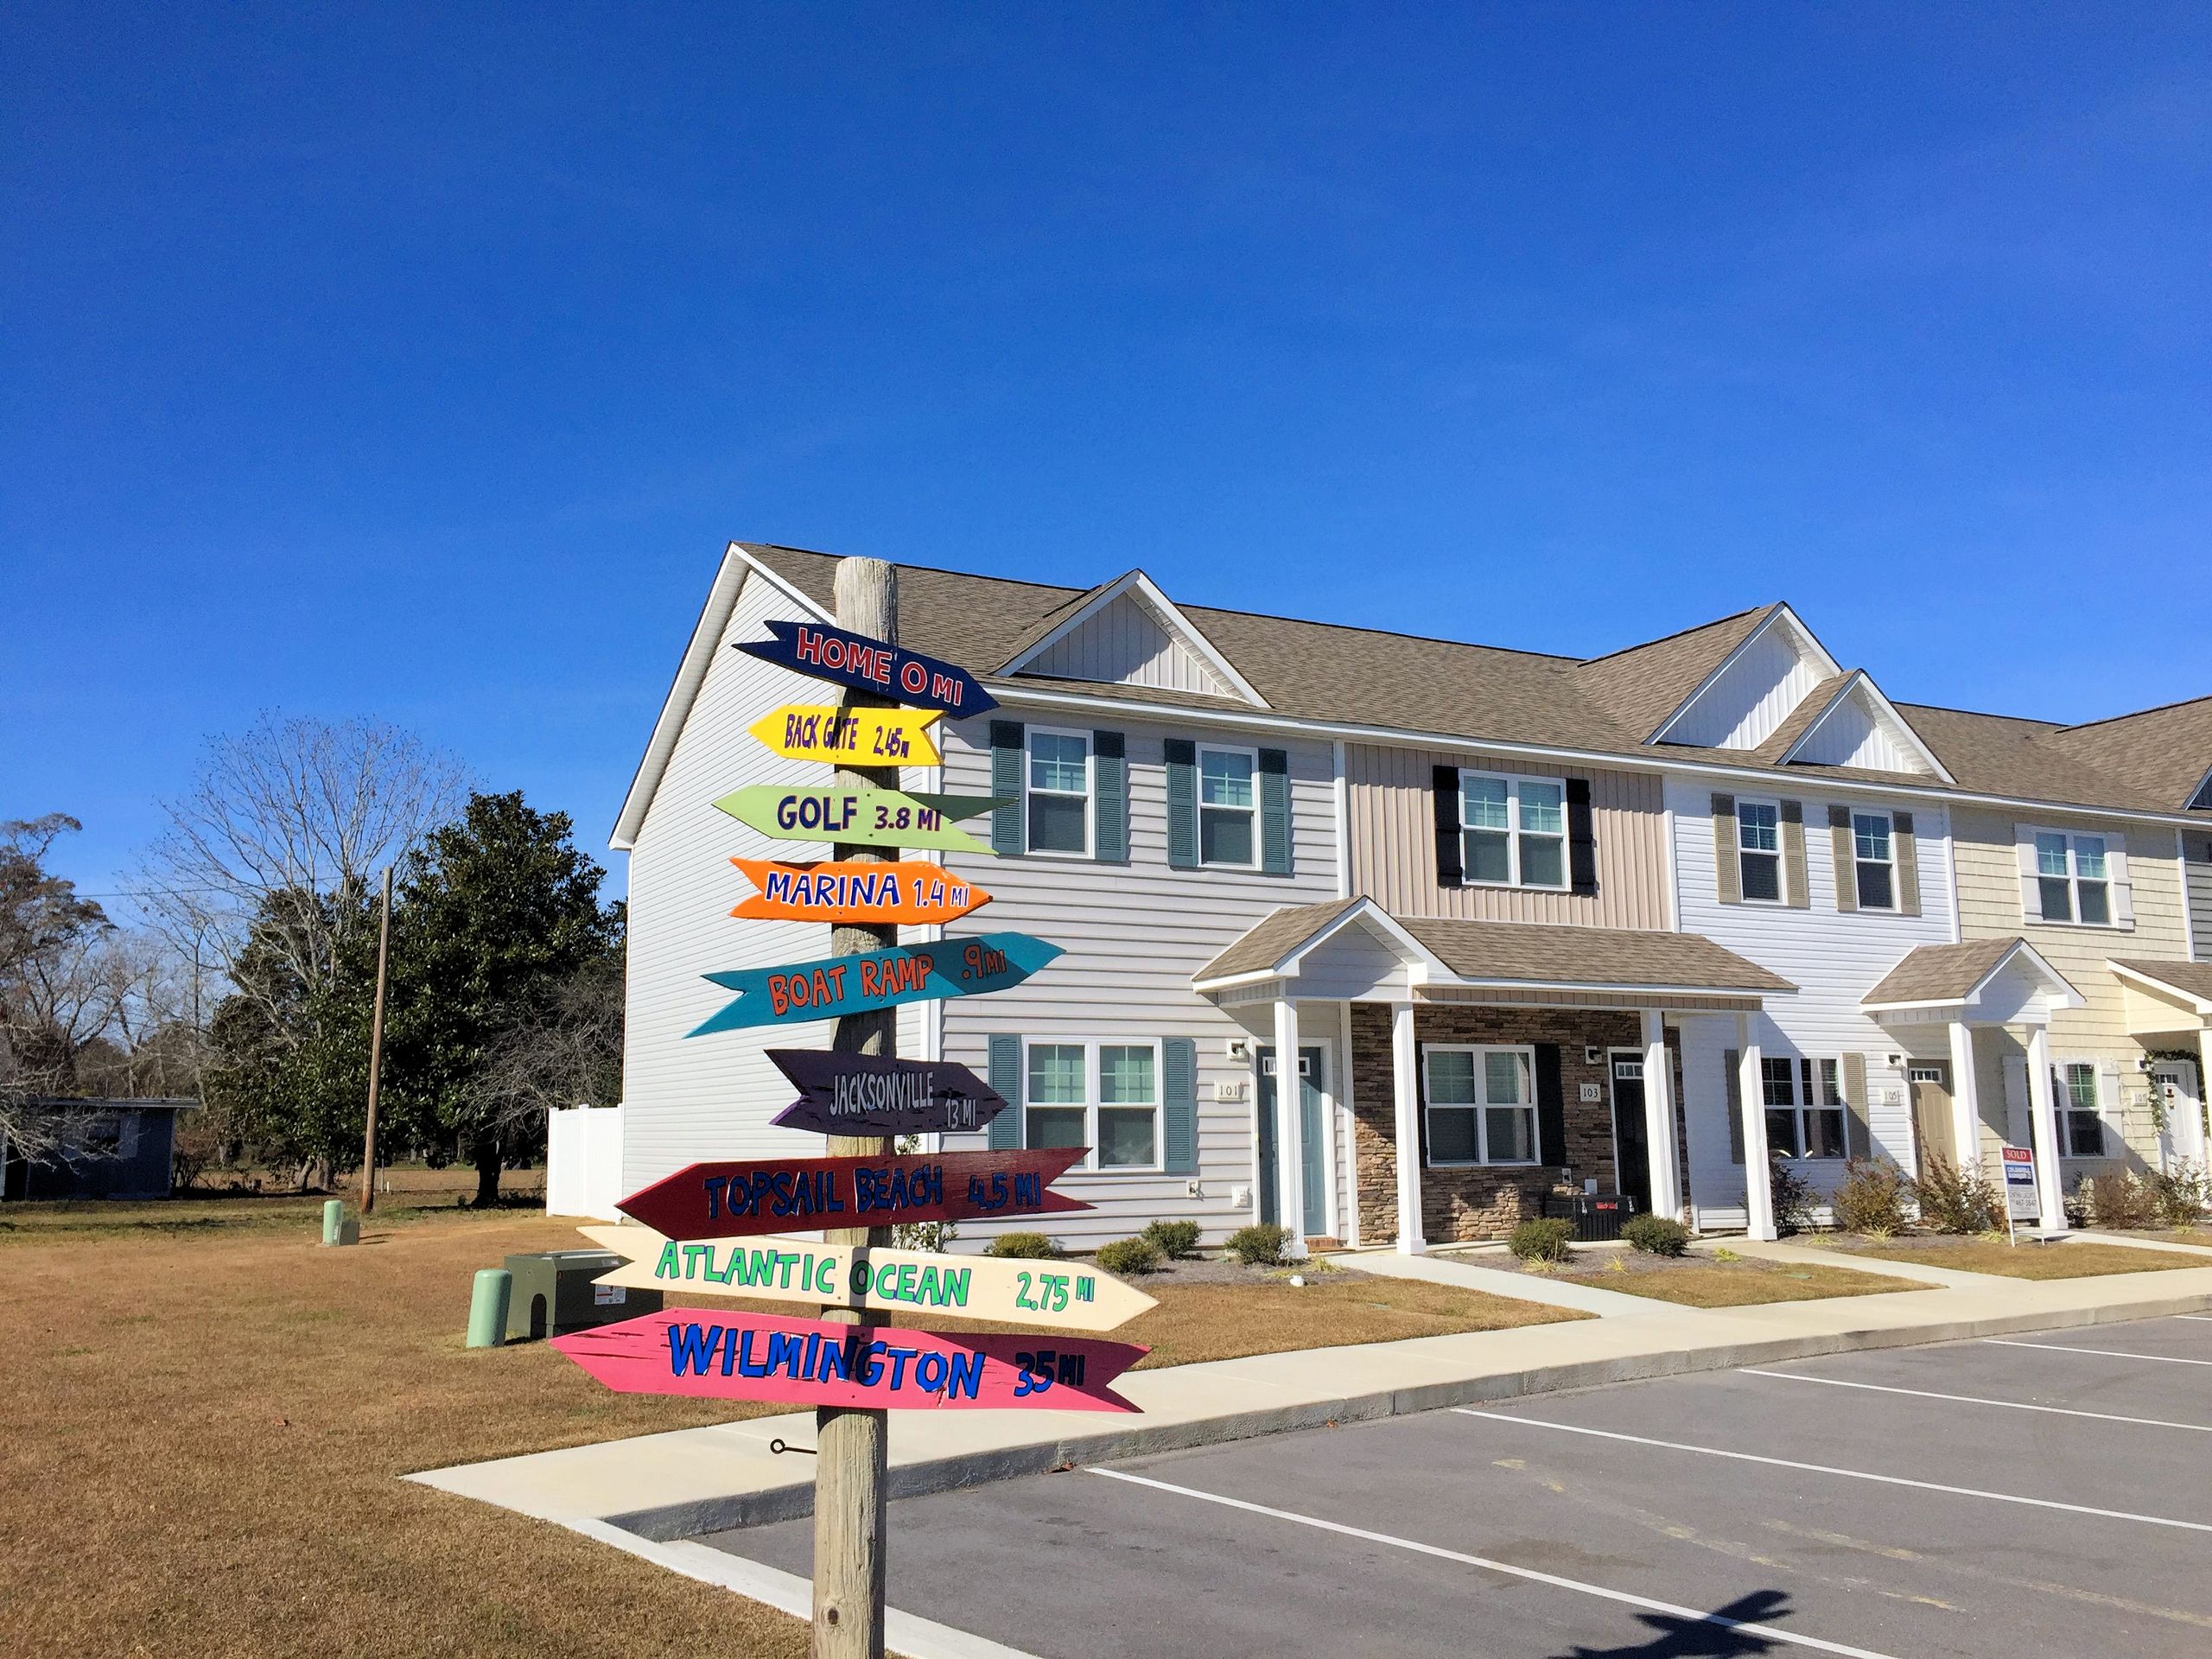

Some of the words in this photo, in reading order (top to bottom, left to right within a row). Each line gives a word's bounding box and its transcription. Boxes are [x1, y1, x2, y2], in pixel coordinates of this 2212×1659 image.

[796, 627, 893, 684] HOME
[931, 673, 963, 707] MI
[785, 714, 821, 749] BACK
[823, 715, 859, 750] GATE
[778, 795, 857, 832] GOLF
[874, 805, 911, 830] 3.8
[918, 809, 942, 832] MI
[764, 871, 903, 907] MARINA
[912, 878, 944, 907] 1.4
[950, 886, 969, 908] MI
[767, 963, 846, 1016] BOAT
[860, 954, 934, 997] RAMP
[830, 1071, 934, 1116] JACKSONVILLE
[945, 1099, 959, 1129] 13
[963, 1098, 976, 1127] MI
[1220, 1085, 1237, 1096] 101
[1583, 1088, 1599, 1098] 103
[2005, 1149, 2027, 1160] SOLD
[704, 1171, 845, 1219] TOPSAIL
[855, 1165, 944, 1211] BEACH
[968, 1173, 1008, 1210] 4.5
[1014, 1172, 1042, 1206] MI
[654, 1241, 836, 1294] ATLANTIC
[849, 1258, 972, 1307] OCEAN
[1015, 1271, 1070, 1313] 2.75
[1076, 1275, 1095, 1303] MI
[667, 1323, 985, 1400] WILMINGTON
[1014, 1351, 1056, 1397] 35
[1058, 1353, 1086, 1388] MI
